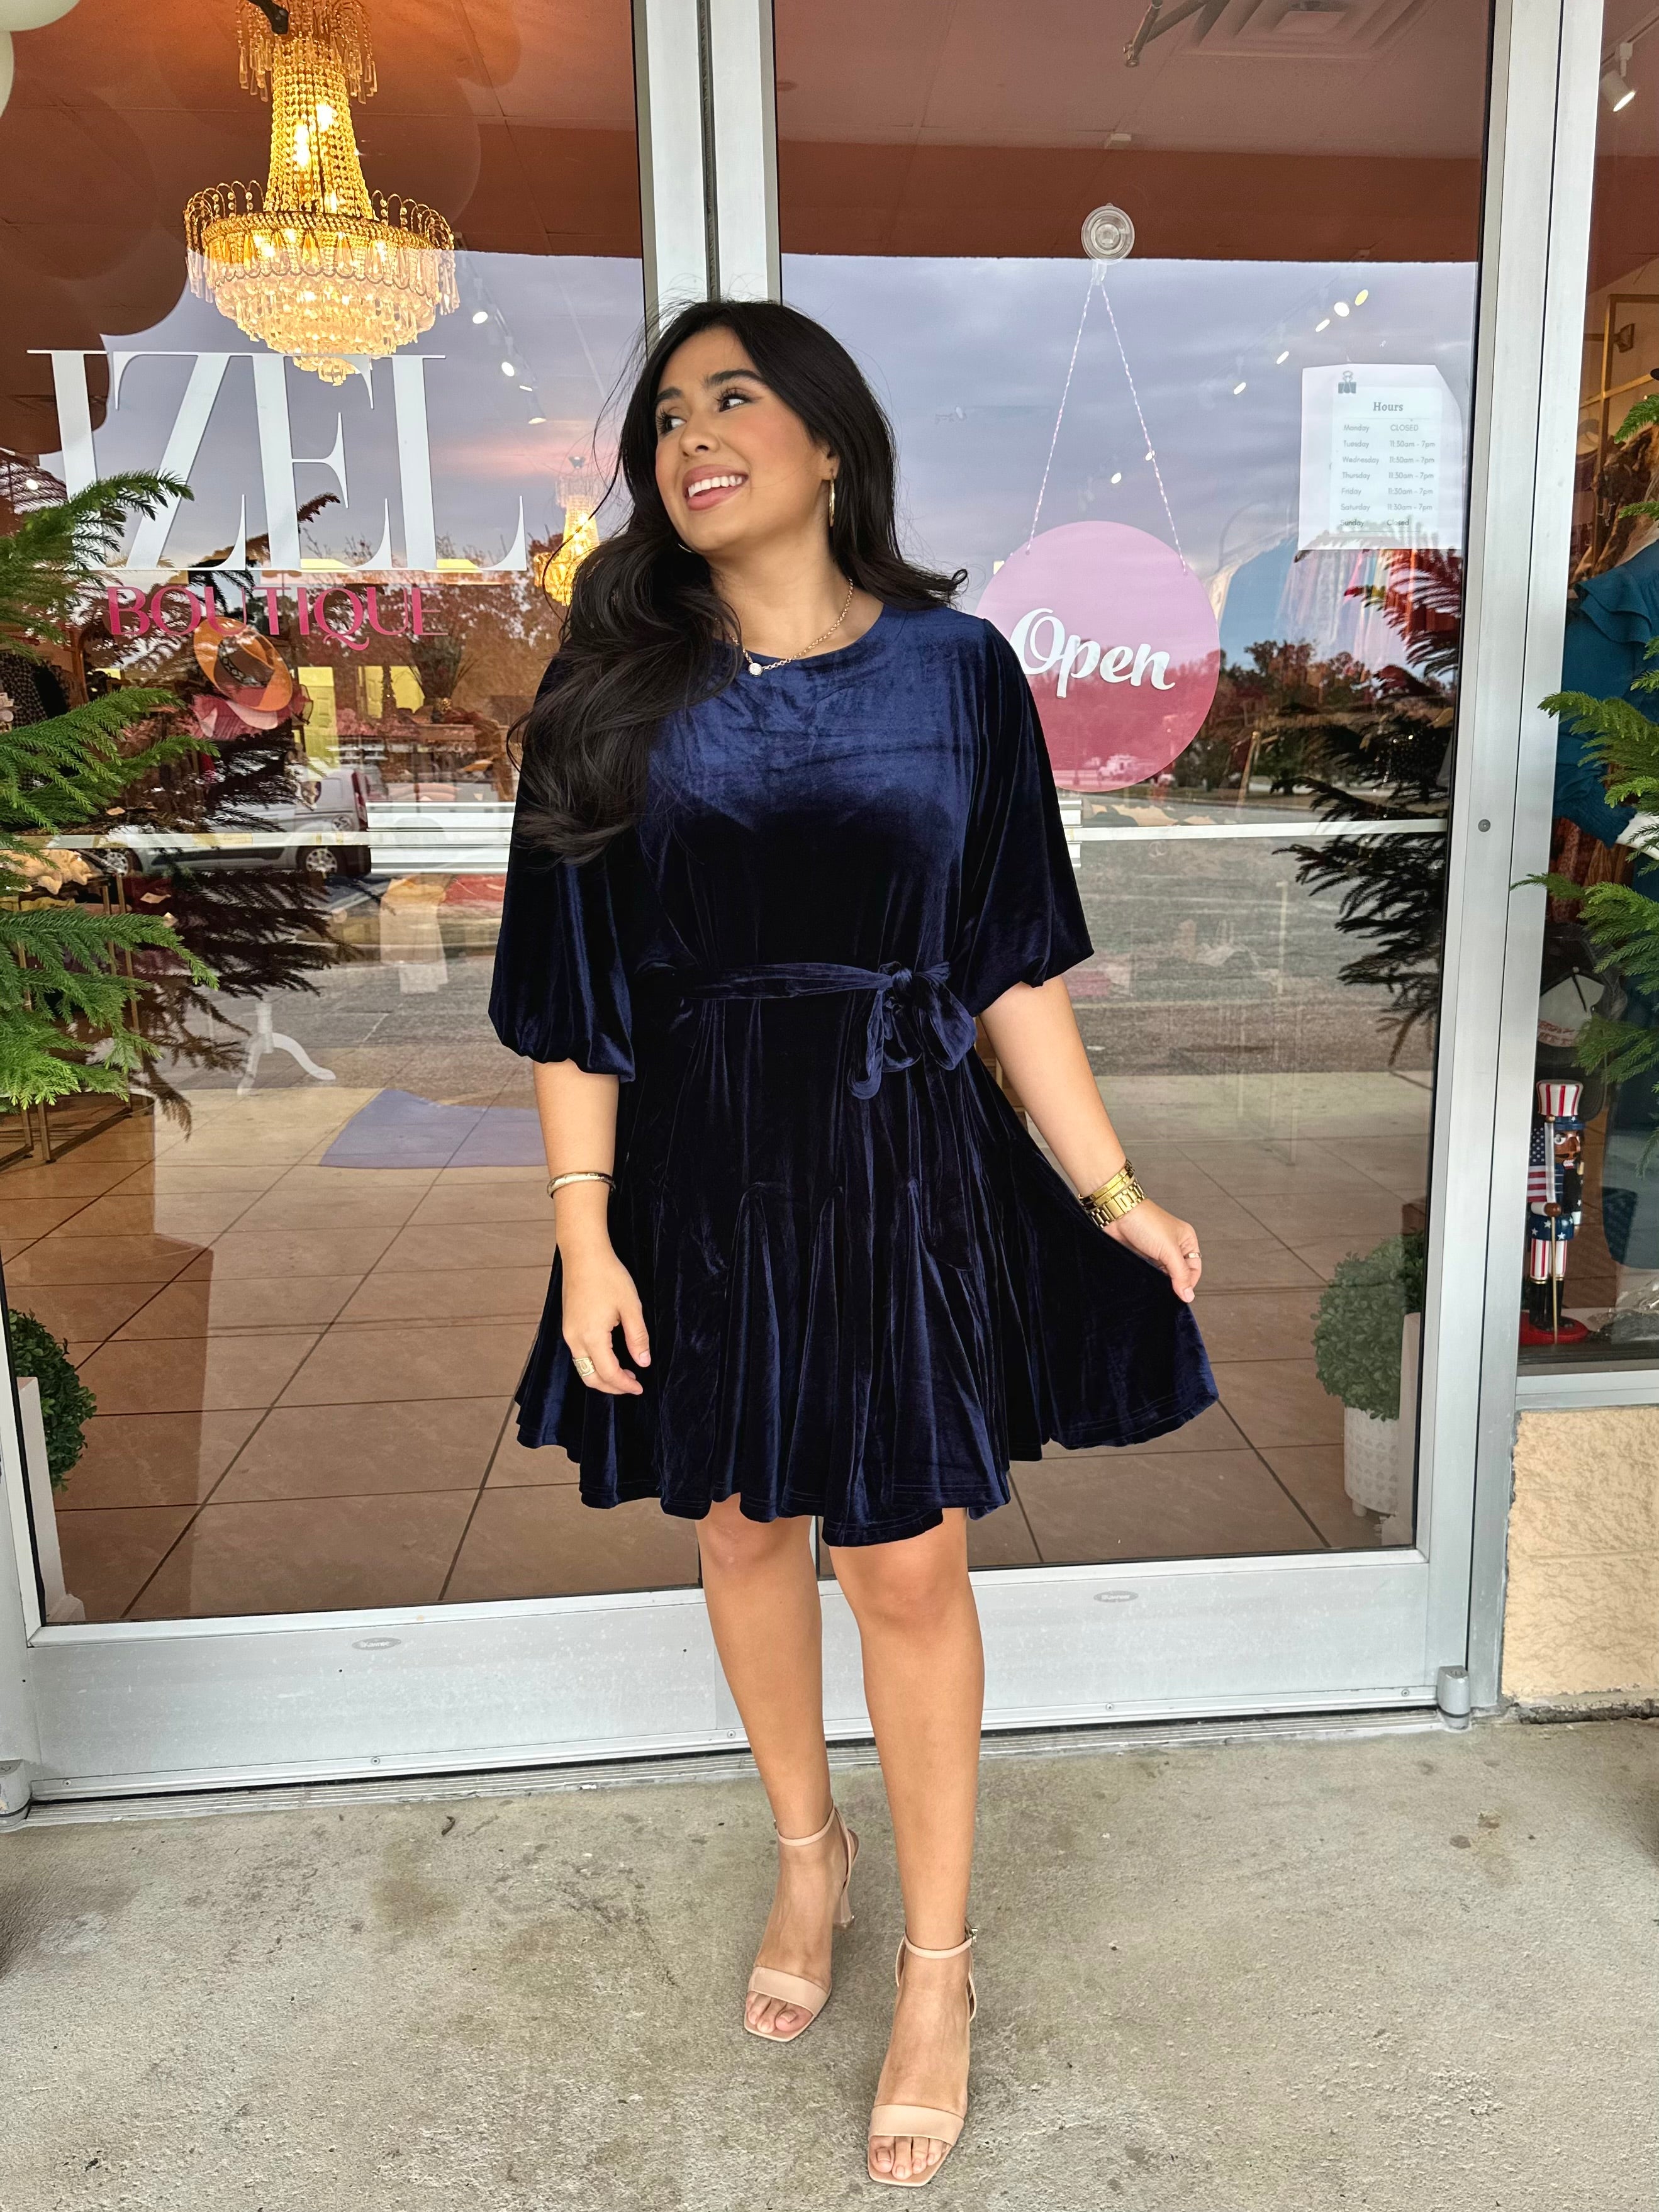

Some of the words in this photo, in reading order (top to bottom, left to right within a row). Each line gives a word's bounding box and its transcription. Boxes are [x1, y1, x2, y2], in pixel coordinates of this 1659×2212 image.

[1373, 402, 1403, 411] Hours
[1343, 424, 1369, 432] Monday
[1343, 440, 1369, 449] Tuesday
[1421, 440, 1435, 449] 7pm
[27, 349, 527, 572] IZEL
[1343, 456, 1379, 465] Wednesday
[1342, 472, 1370, 480] Thursday
[1420, 472, 1434, 480] 7pm
[1341, 503, 1370, 511] Saturday
[1419, 503, 1433, 511] 7pm
[1340, 519, 1364, 527] Sunday
[107, 586, 449, 651] BOUTIQUE
[1009, 607, 1176, 699] Open
